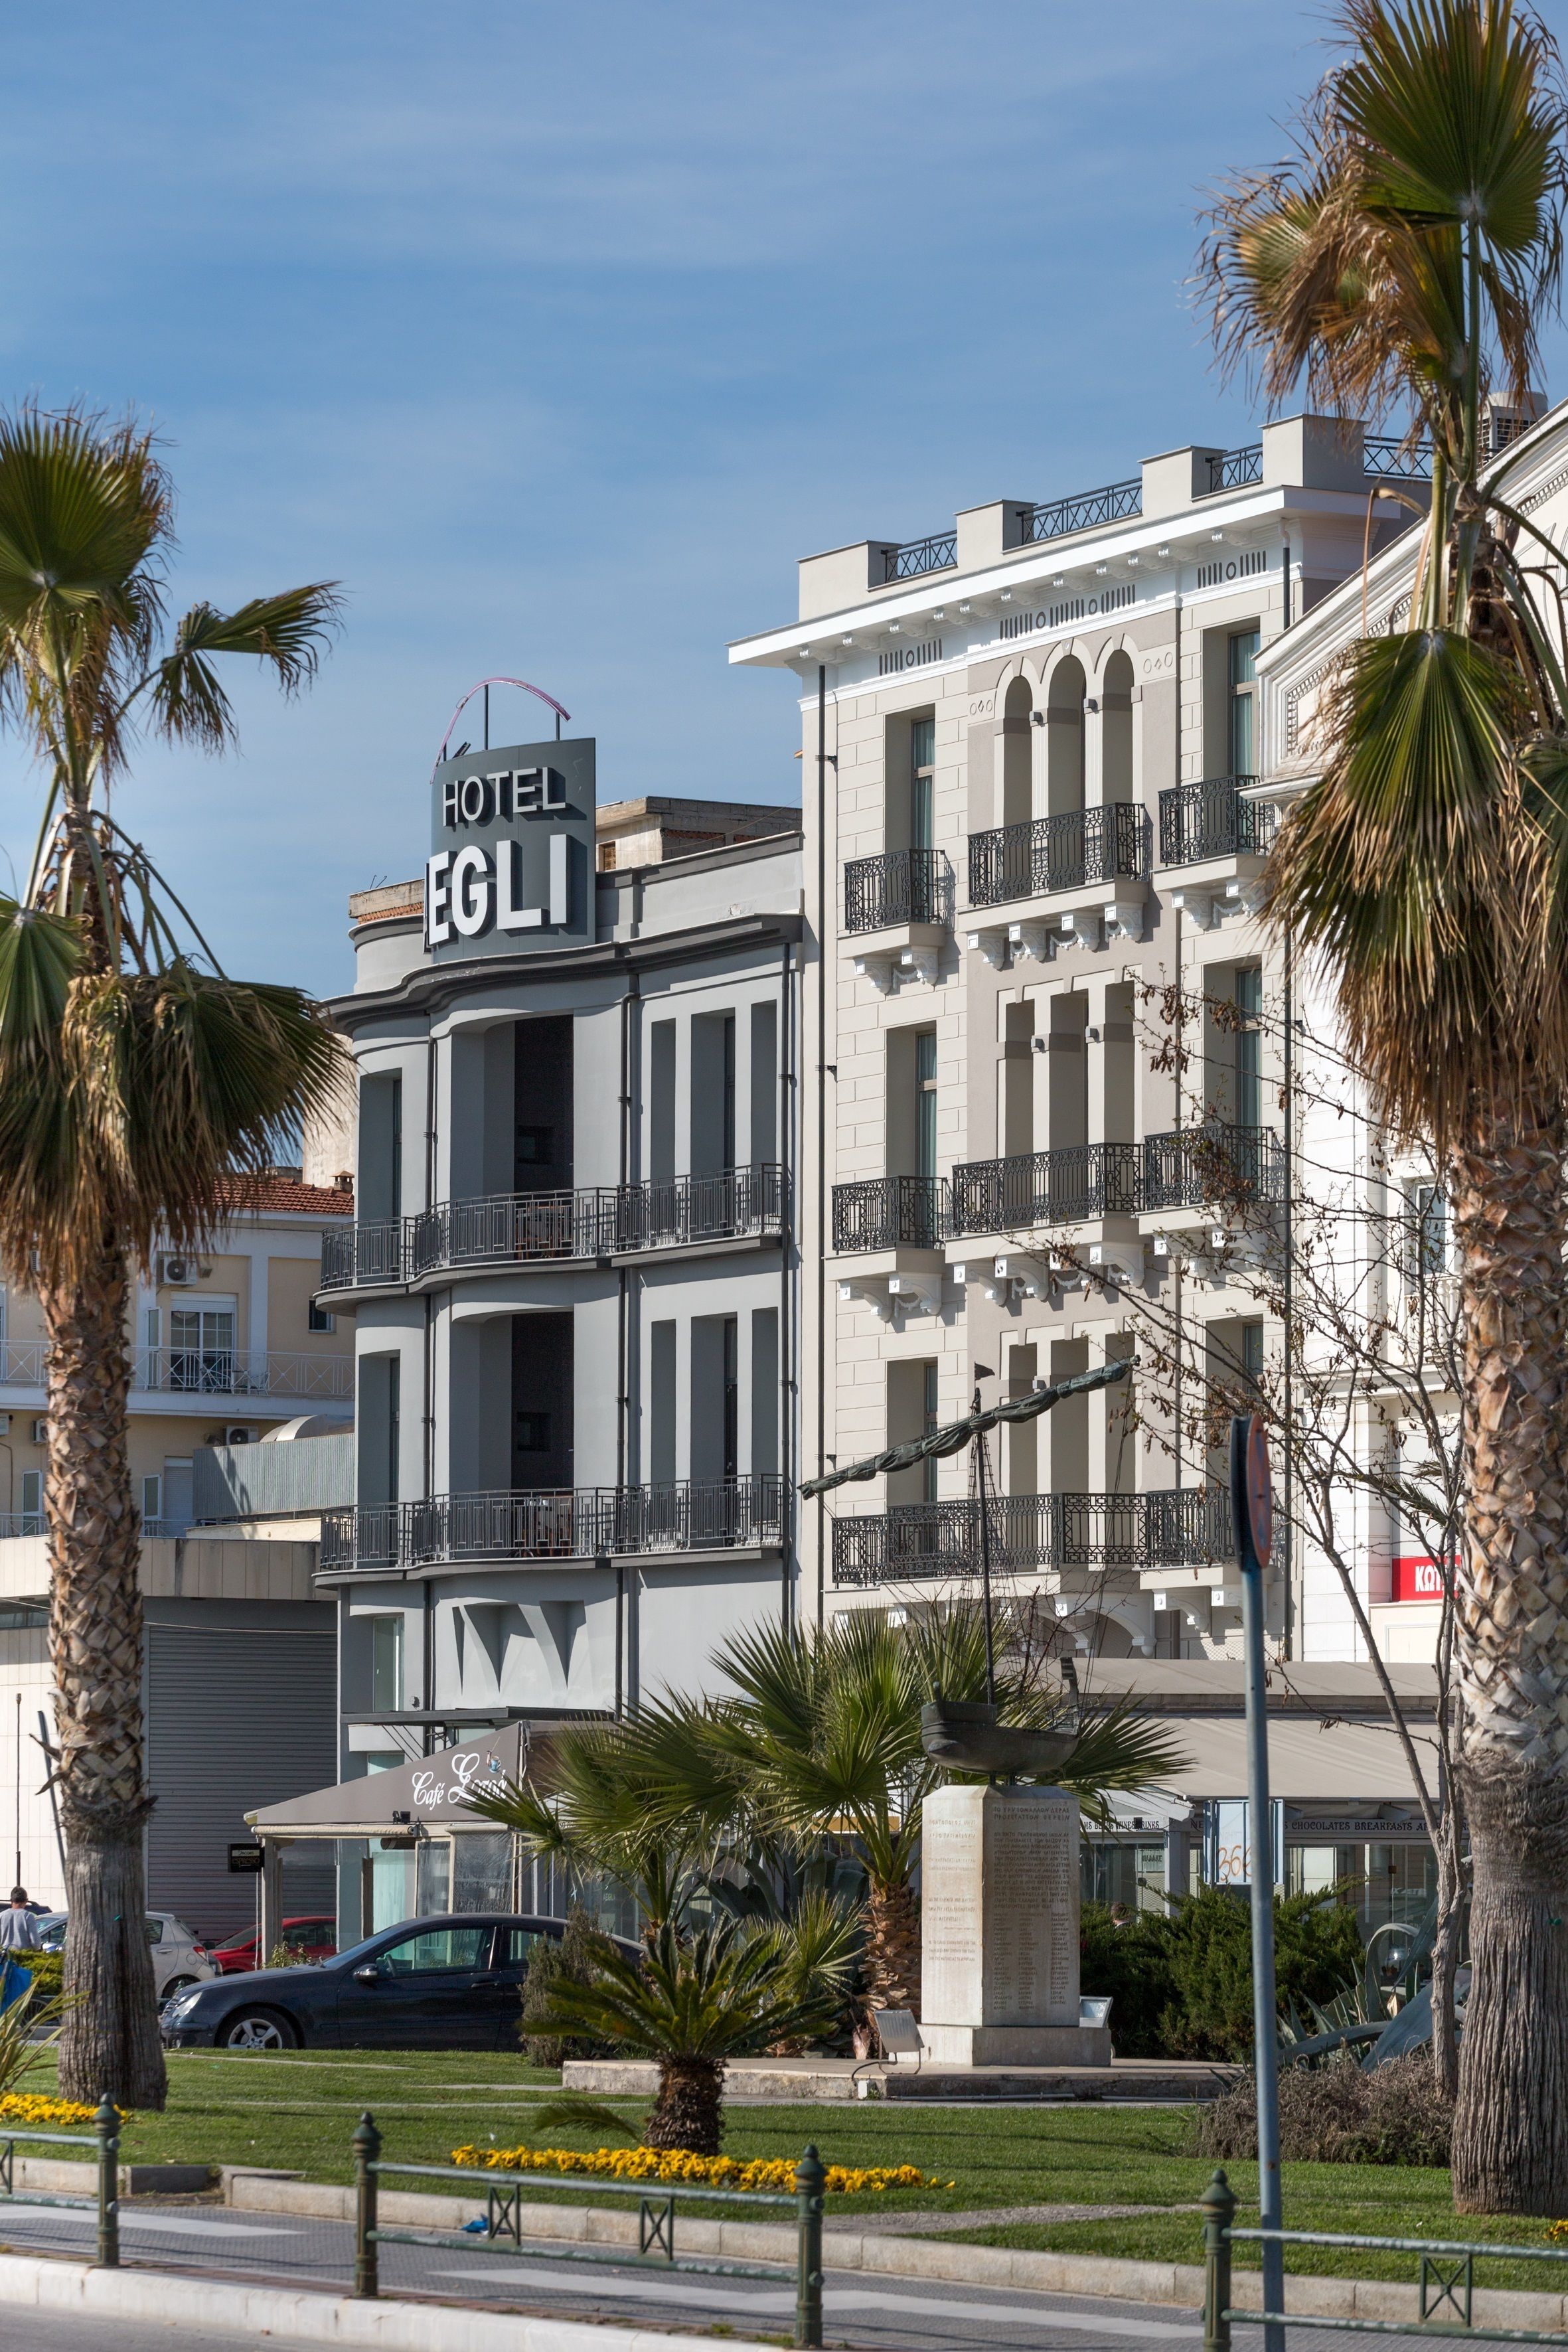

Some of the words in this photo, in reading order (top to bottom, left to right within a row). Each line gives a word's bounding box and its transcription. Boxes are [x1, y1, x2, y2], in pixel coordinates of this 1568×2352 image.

[443, 767, 566, 826] HOTEL
[412, 1771, 445, 1810] Café
[1141, 1820, 1160, 1830] RINKS
[1292, 1821, 1350, 1831] CHOCOLATES
[1354, 1821, 1413, 1832] BREAKFASTS
